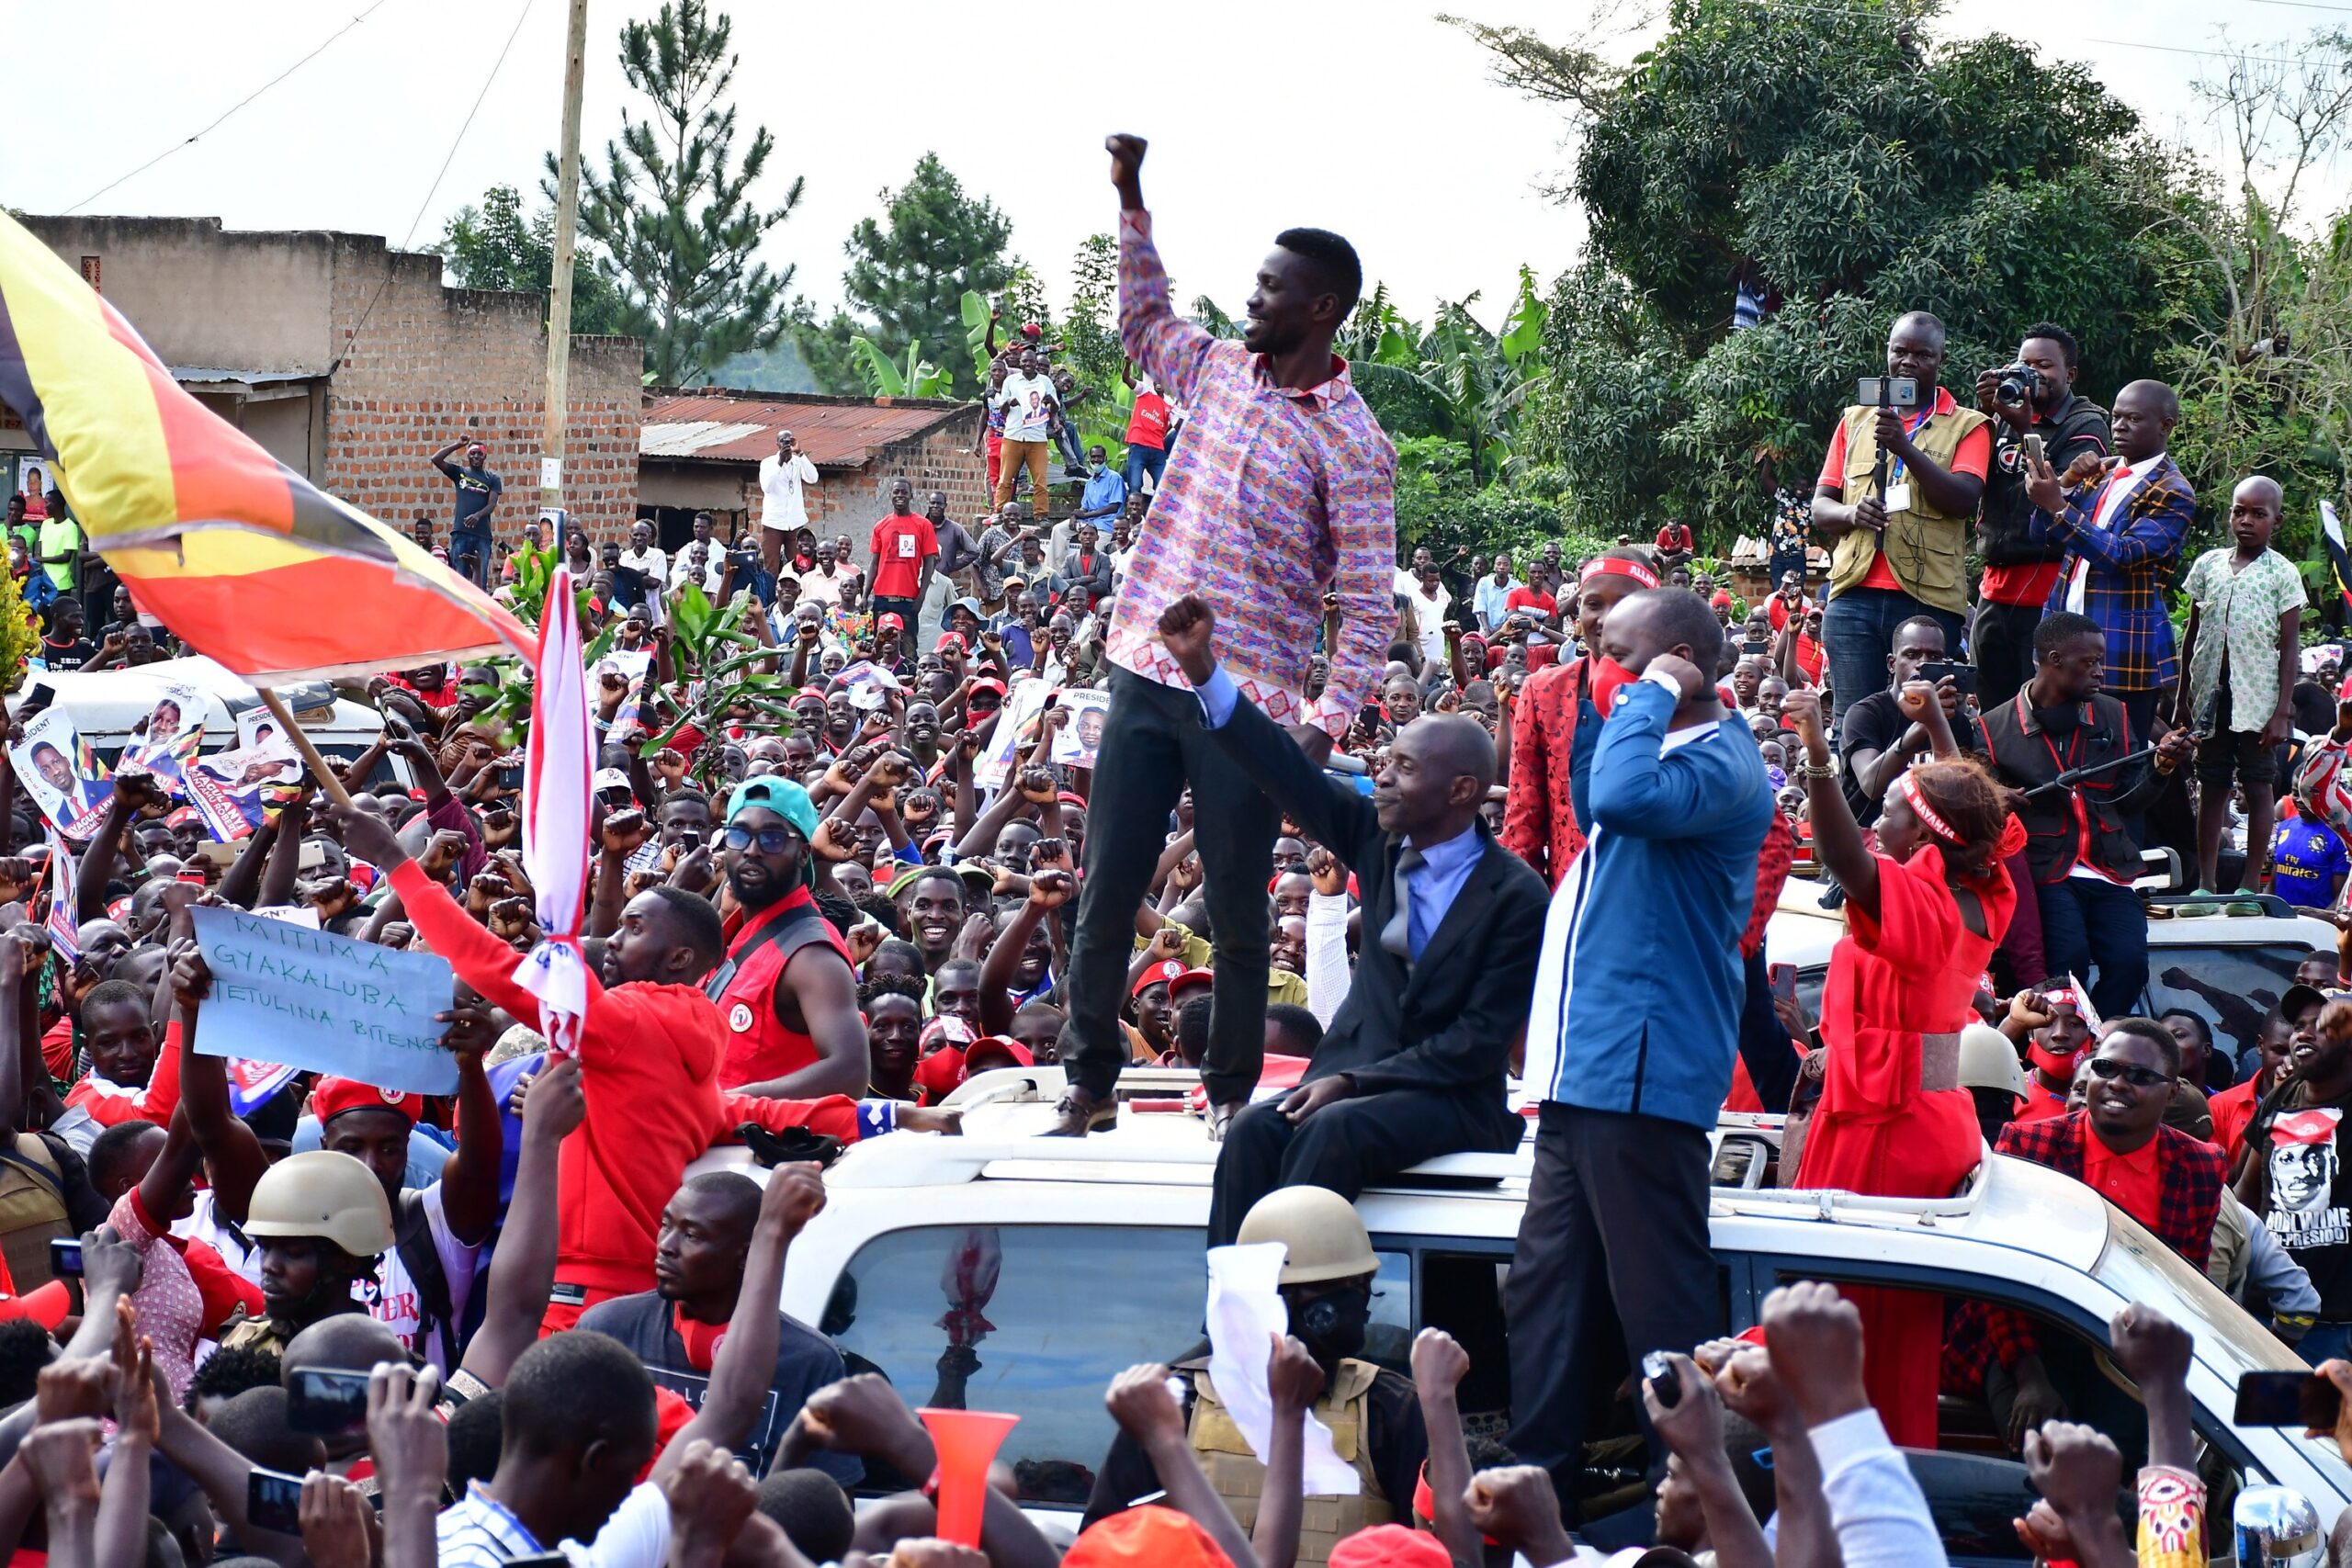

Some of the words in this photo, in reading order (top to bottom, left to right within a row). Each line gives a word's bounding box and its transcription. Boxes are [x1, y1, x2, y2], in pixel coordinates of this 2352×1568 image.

[1922, 447, 1948, 459] PRESS
[1073, 691, 1110, 705] PRESIDE
[247, 711, 275, 724] PRESIDE
[192, 803, 212, 830] UGANDA
[212, 802, 239, 833] ROBERT
[1912, 795, 1956, 840] MAYANJA
[2276, 863, 2320, 879] mirates
[2284, 853, 2301, 865] Fly
[213, 944, 411, 1016] GYAKALUBA
[210, 976, 334, 1029] TETULINA
[2299, 1207, 2351, 1232] WINE
